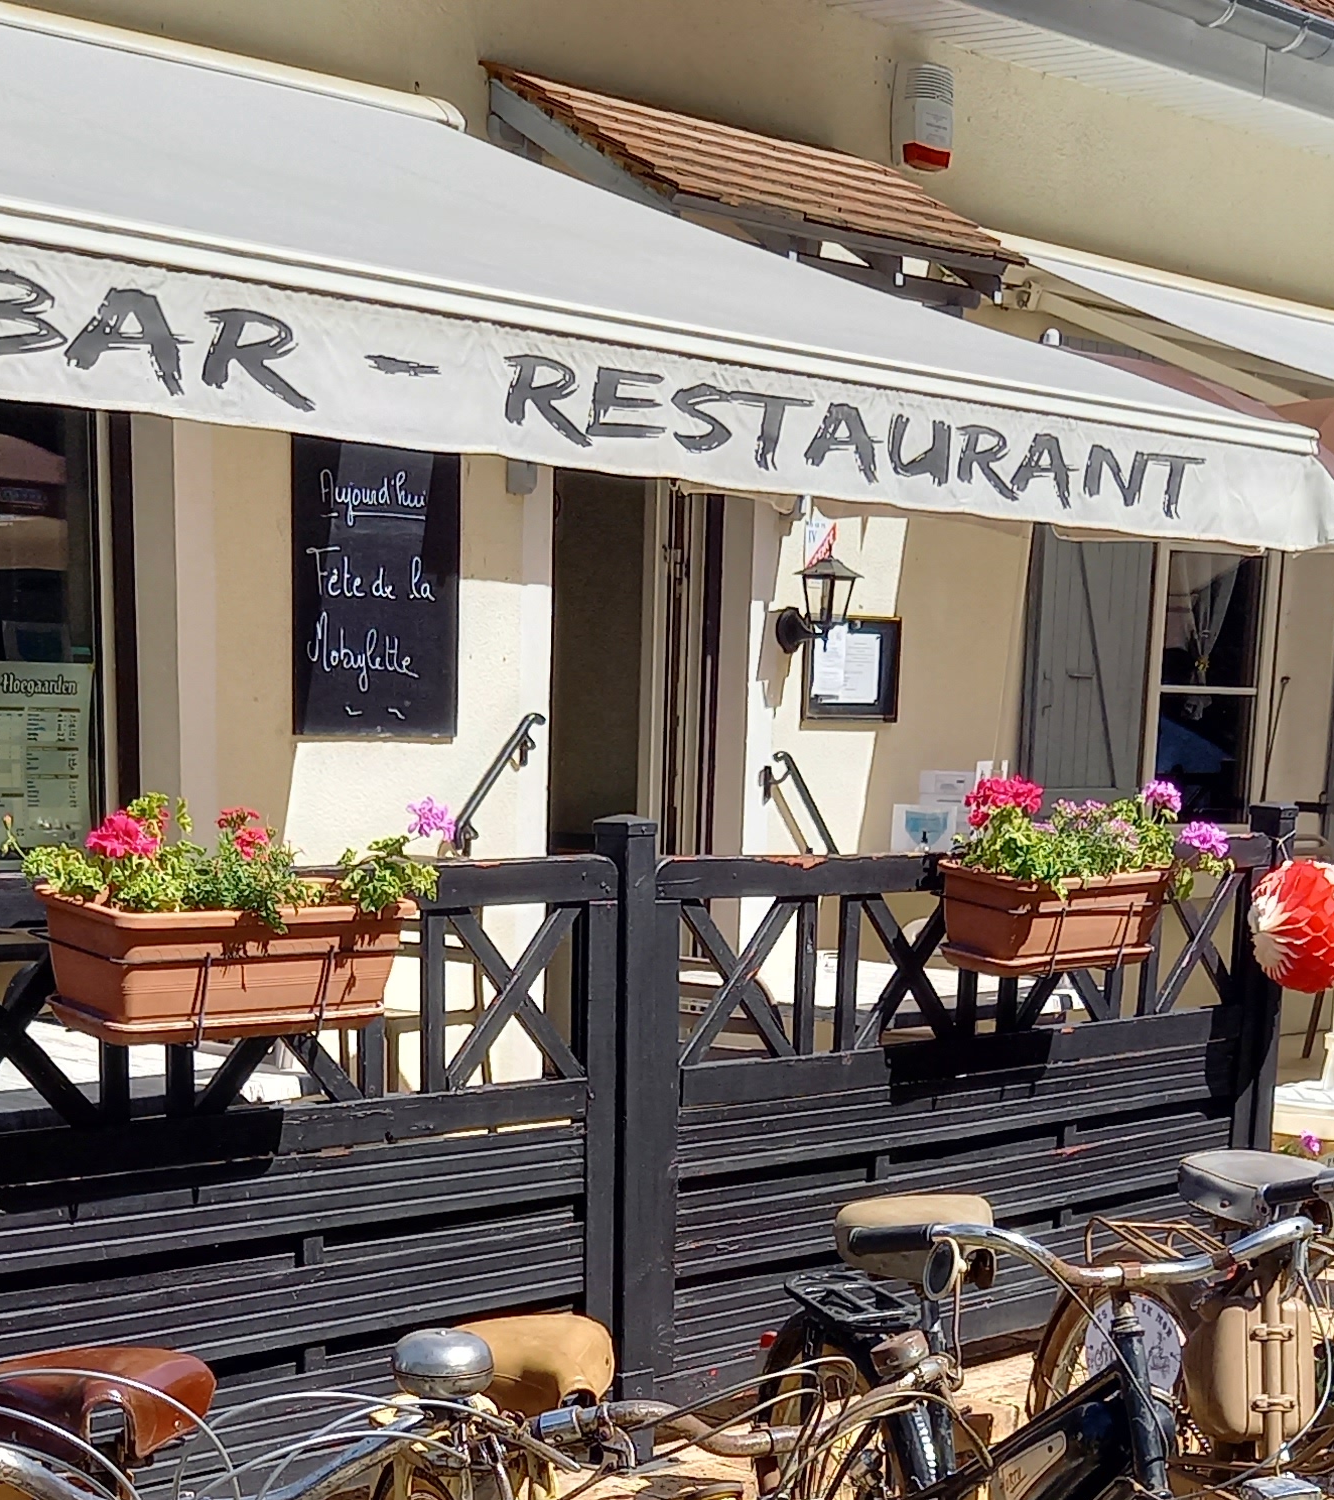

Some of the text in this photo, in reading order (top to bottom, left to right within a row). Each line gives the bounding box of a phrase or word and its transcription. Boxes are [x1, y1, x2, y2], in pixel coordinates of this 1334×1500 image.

[503, 354, 1207, 520] RESTAURANT
[319, 468, 428, 526] Aujourd'hui
[371, 566, 397, 600] de
[408, 555, 436, 602] la
[306, 610, 420, 693] Mobylette
[0, 672, 79, 697] Hoegaarden
